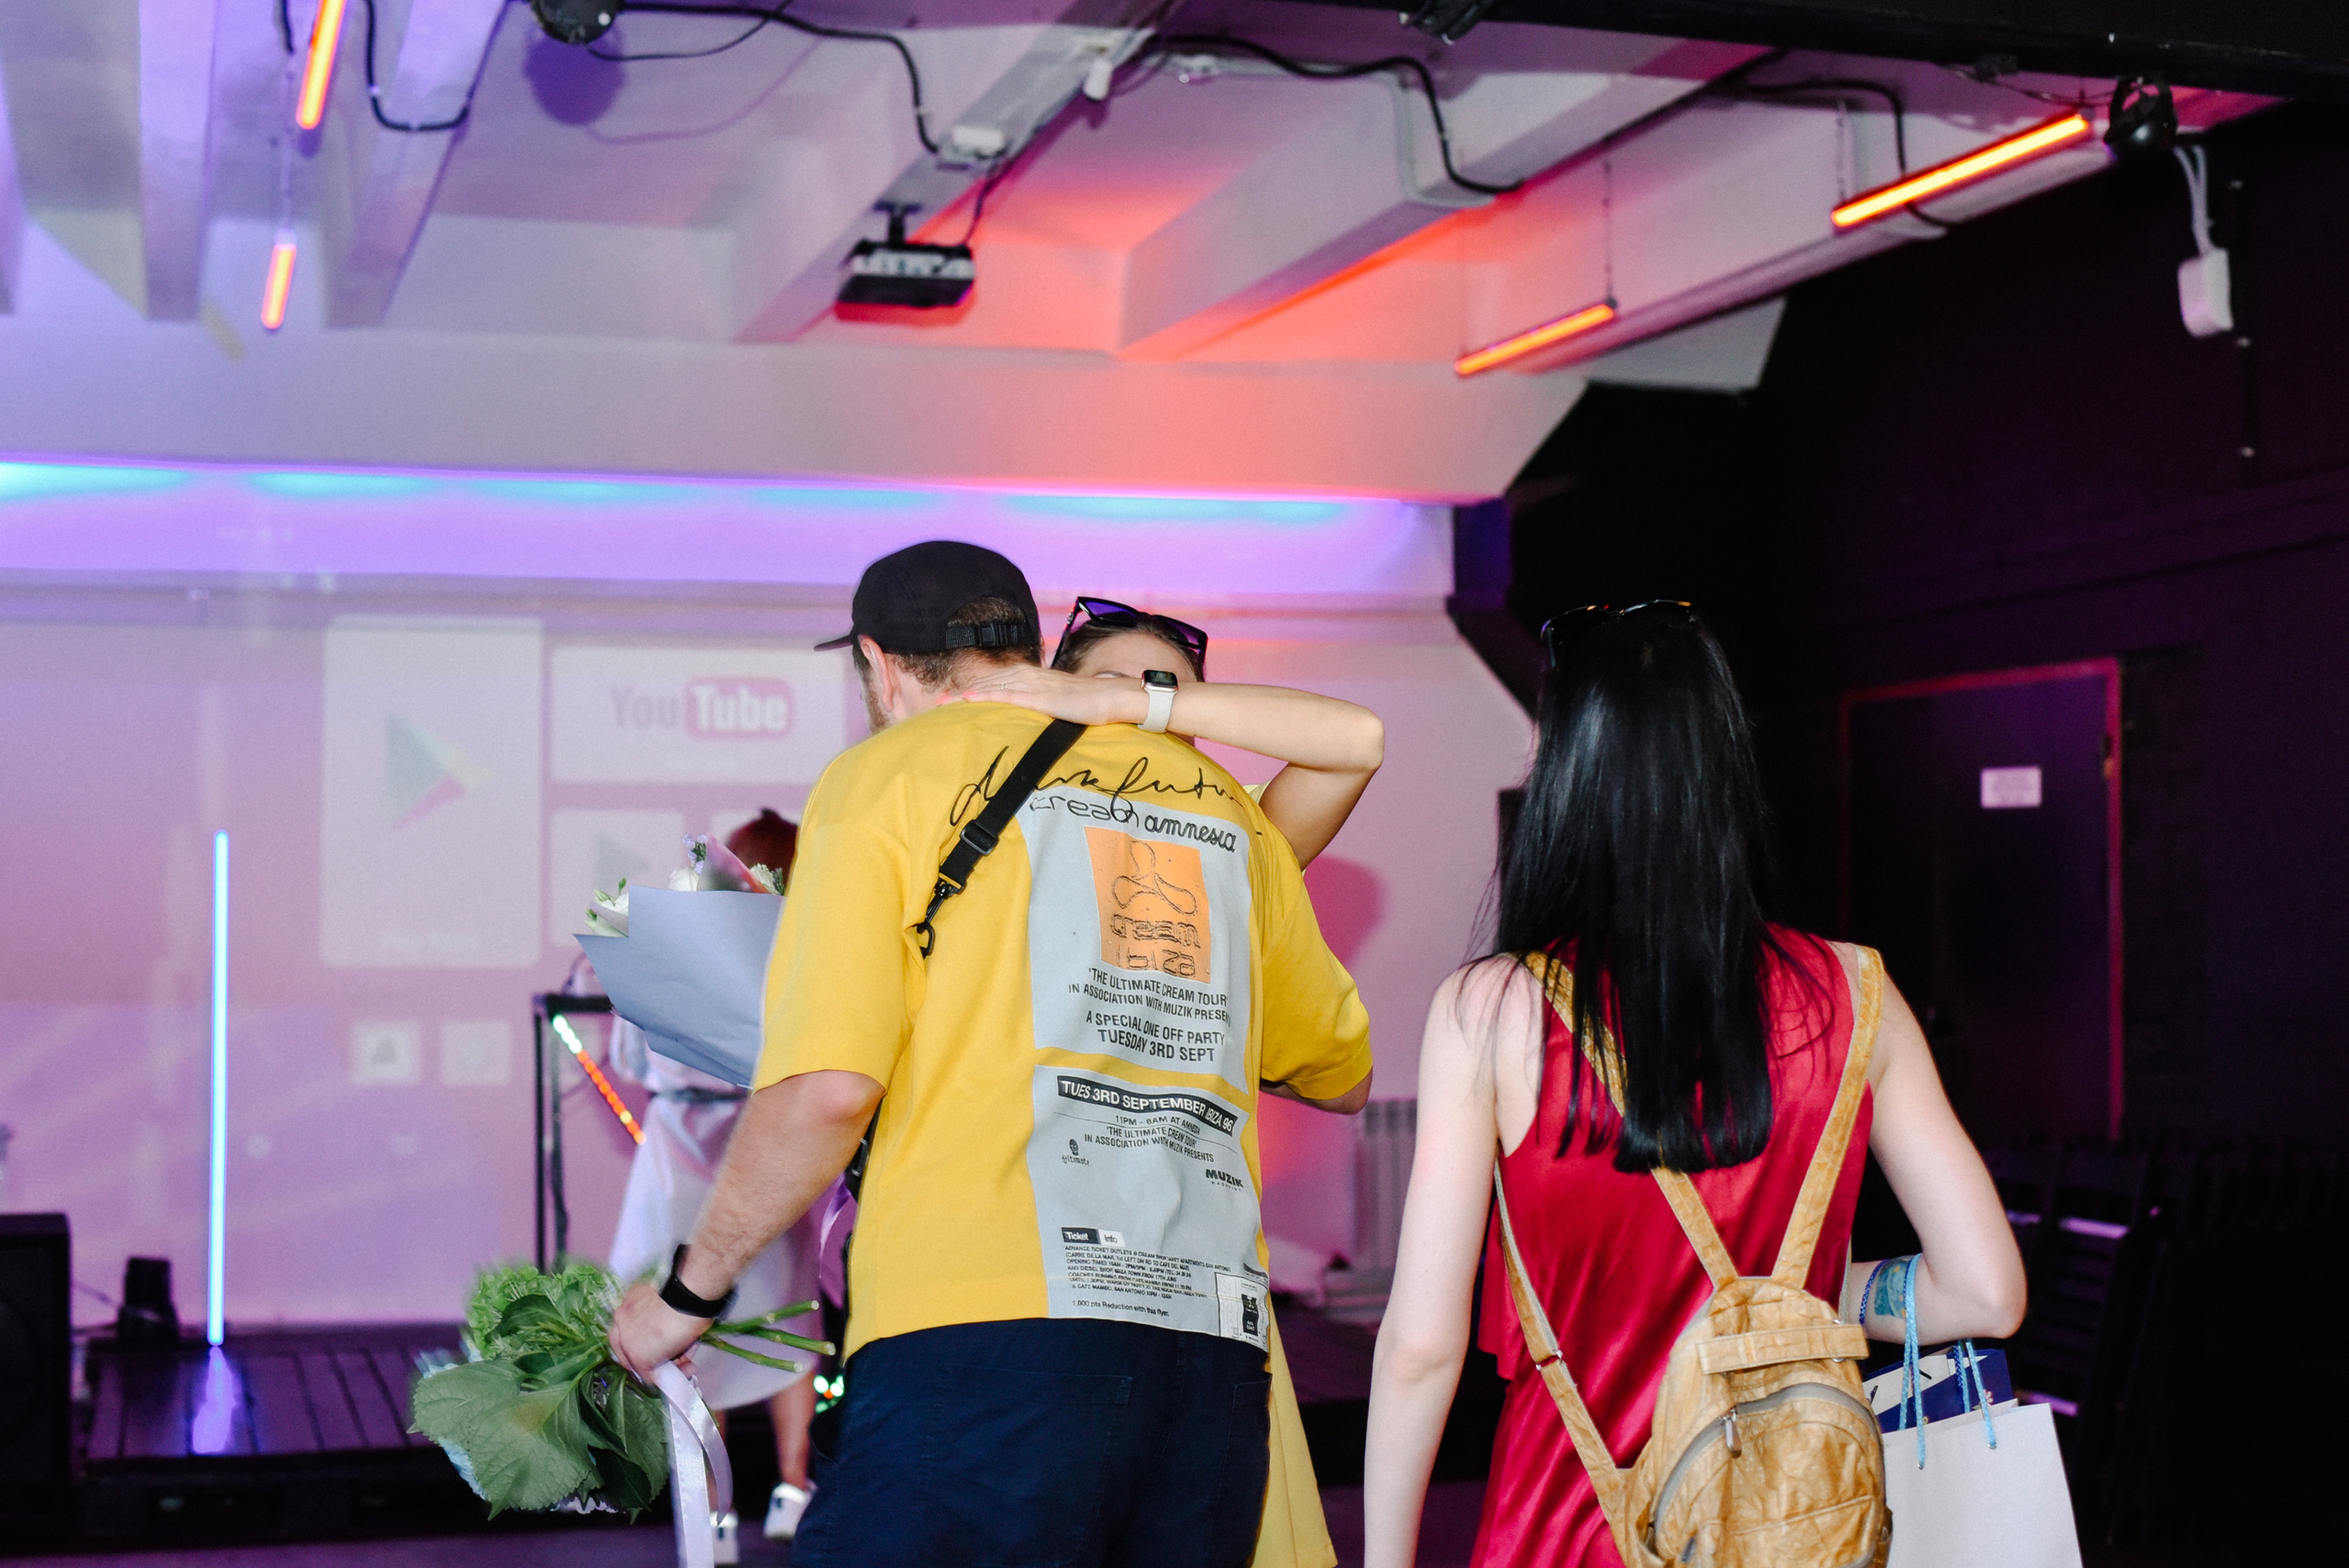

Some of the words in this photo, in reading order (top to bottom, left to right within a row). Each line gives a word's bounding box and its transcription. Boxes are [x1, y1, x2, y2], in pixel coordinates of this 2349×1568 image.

[1144, 815, 1236, 851] amnesia
[1068, 984, 1080, 994] IN
[1083, 984, 1142, 1005] ASSOCIATION
[1146, 995, 1163, 1011] WITH
[1163, 1002, 1192, 1018] MUZIK
[1109, 977, 1161, 994] ULTIMATE
[1162, 984, 1195, 1003] CREAM
[1086, 1010, 1092, 1025] A
[1096, 1013, 1142, 1031] SPECIAL
[1143, 1020, 1160, 1039] ONE
[1163, 1026, 1184, 1042] OFF
[1187, 1031, 1225, 1046] PARTY
[1097, 1029, 1147, 1053] TUESDAY
[1149, 1040, 1174, 1059] 3RD
[1179, 1046, 1216, 1062] SEPT
[1061, 1081, 1091, 1099] TUES
[1092, 1089, 1120, 1105] 3RD
[1122, 1095, 1206, 1117] SEPTEMBER
[1205, 1107, 1222, 1128] IBIZA
[1221, 1118, 1233, 1133] 96
[1116, 1115, 1138, 1126] 11PM
[1170, 1116, 1181, 1125] AT
[1124, 1127, 1167, 1139] ULTIMATE
[1167, 1127, 1186, 1143] CREAM
[1085, 1134, 1093, 1143] IN
[1095, 1134, 1150, 1149] ASSOCIATION
[1152, 1136, 1169, 1148] WITH
[1168, 1140, 1184, 1155] MUZIK
[1184, 1146, 1215, 1162] PRESENTS
[1205, 1168, 1244, 1188] MUZIK
[1063, 1230, 1089, 1241] Ticket
[1110, 1248, 1132, 1256] OUTLETS
[1124, 1256, 1137, 1264] LEFT
[1102, 1301, 1133, 1311] Reduction
[1133, 1305, 1147, 1313] with
[1146, 1307, 1157, 1315] this
